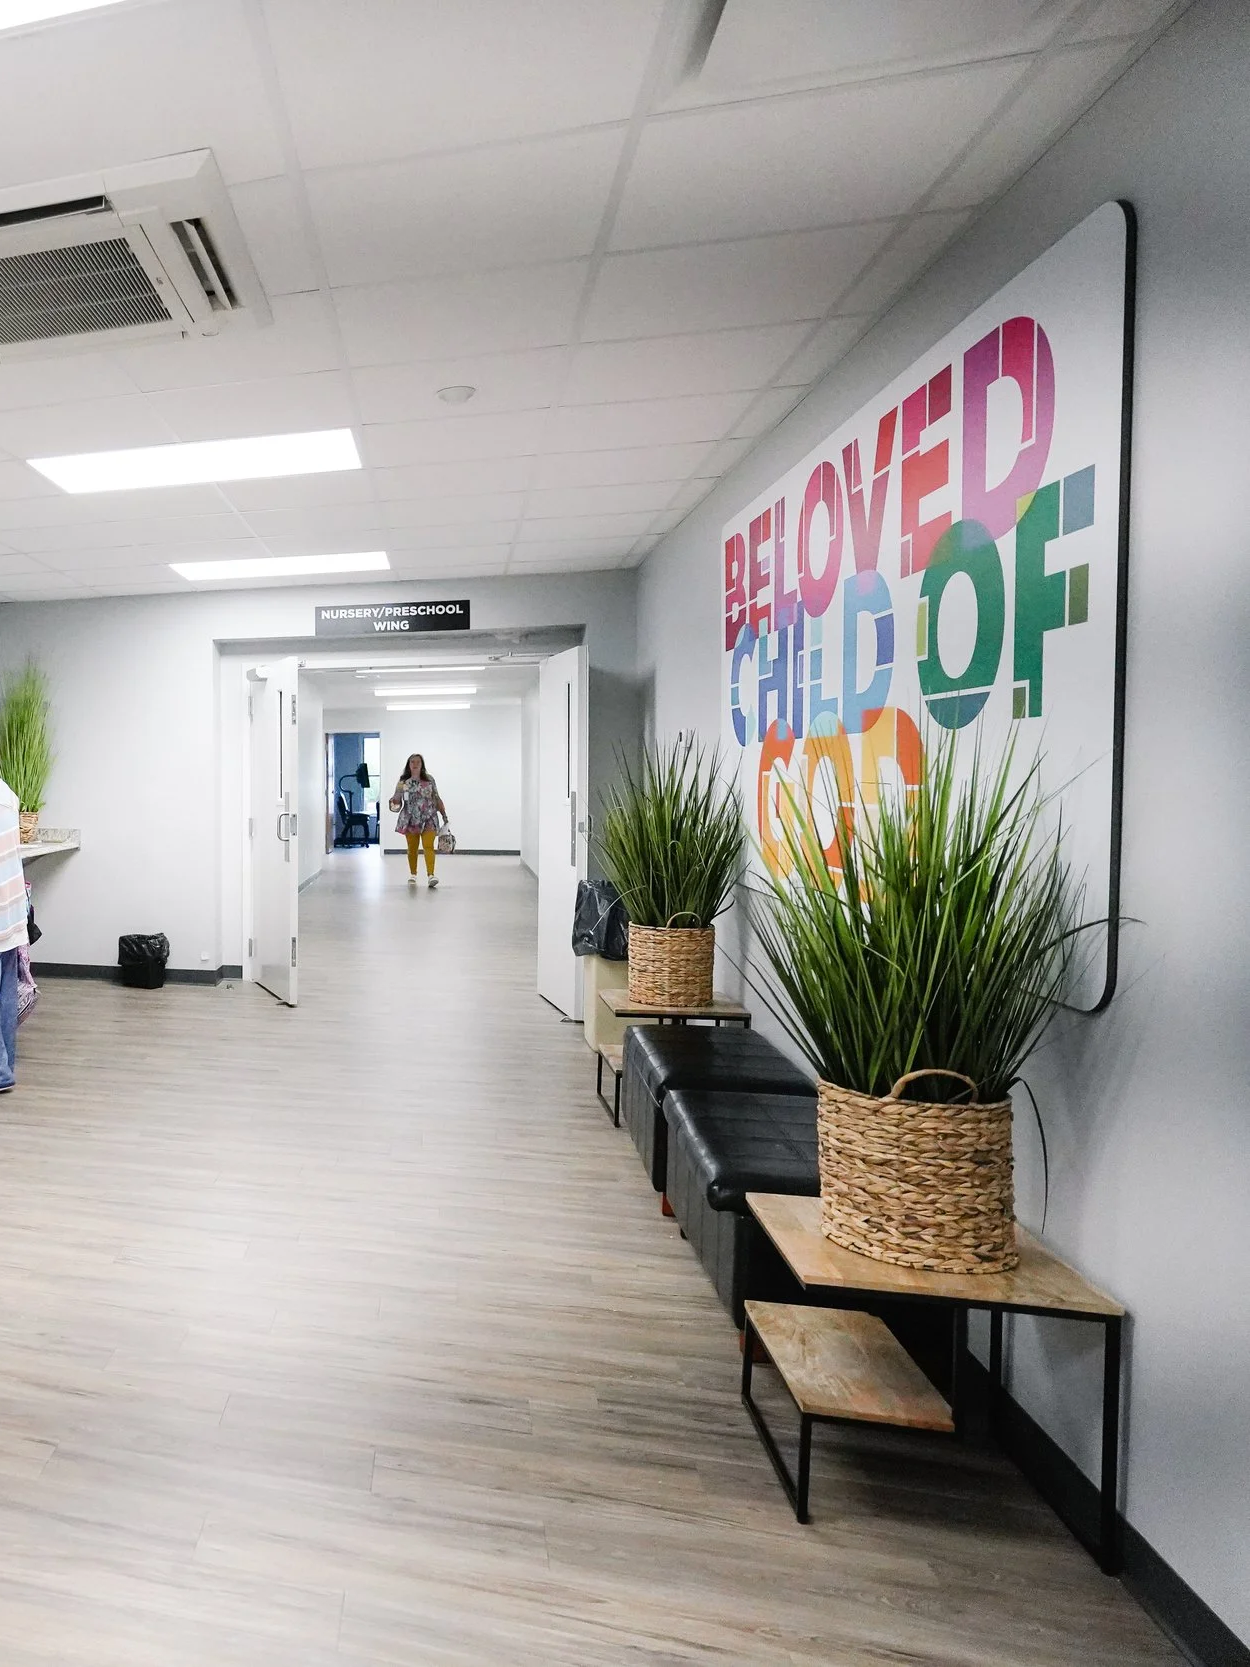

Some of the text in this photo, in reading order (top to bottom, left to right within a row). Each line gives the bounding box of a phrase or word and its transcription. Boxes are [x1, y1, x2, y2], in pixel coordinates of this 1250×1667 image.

[725, 315, 1056, 653] BELOVED
[321, 604, 464, 620] NURSERY/PRESCHOOL
[373, 620, 410, 631] WING
[730, 464, 1096, 747] CHILD OF
